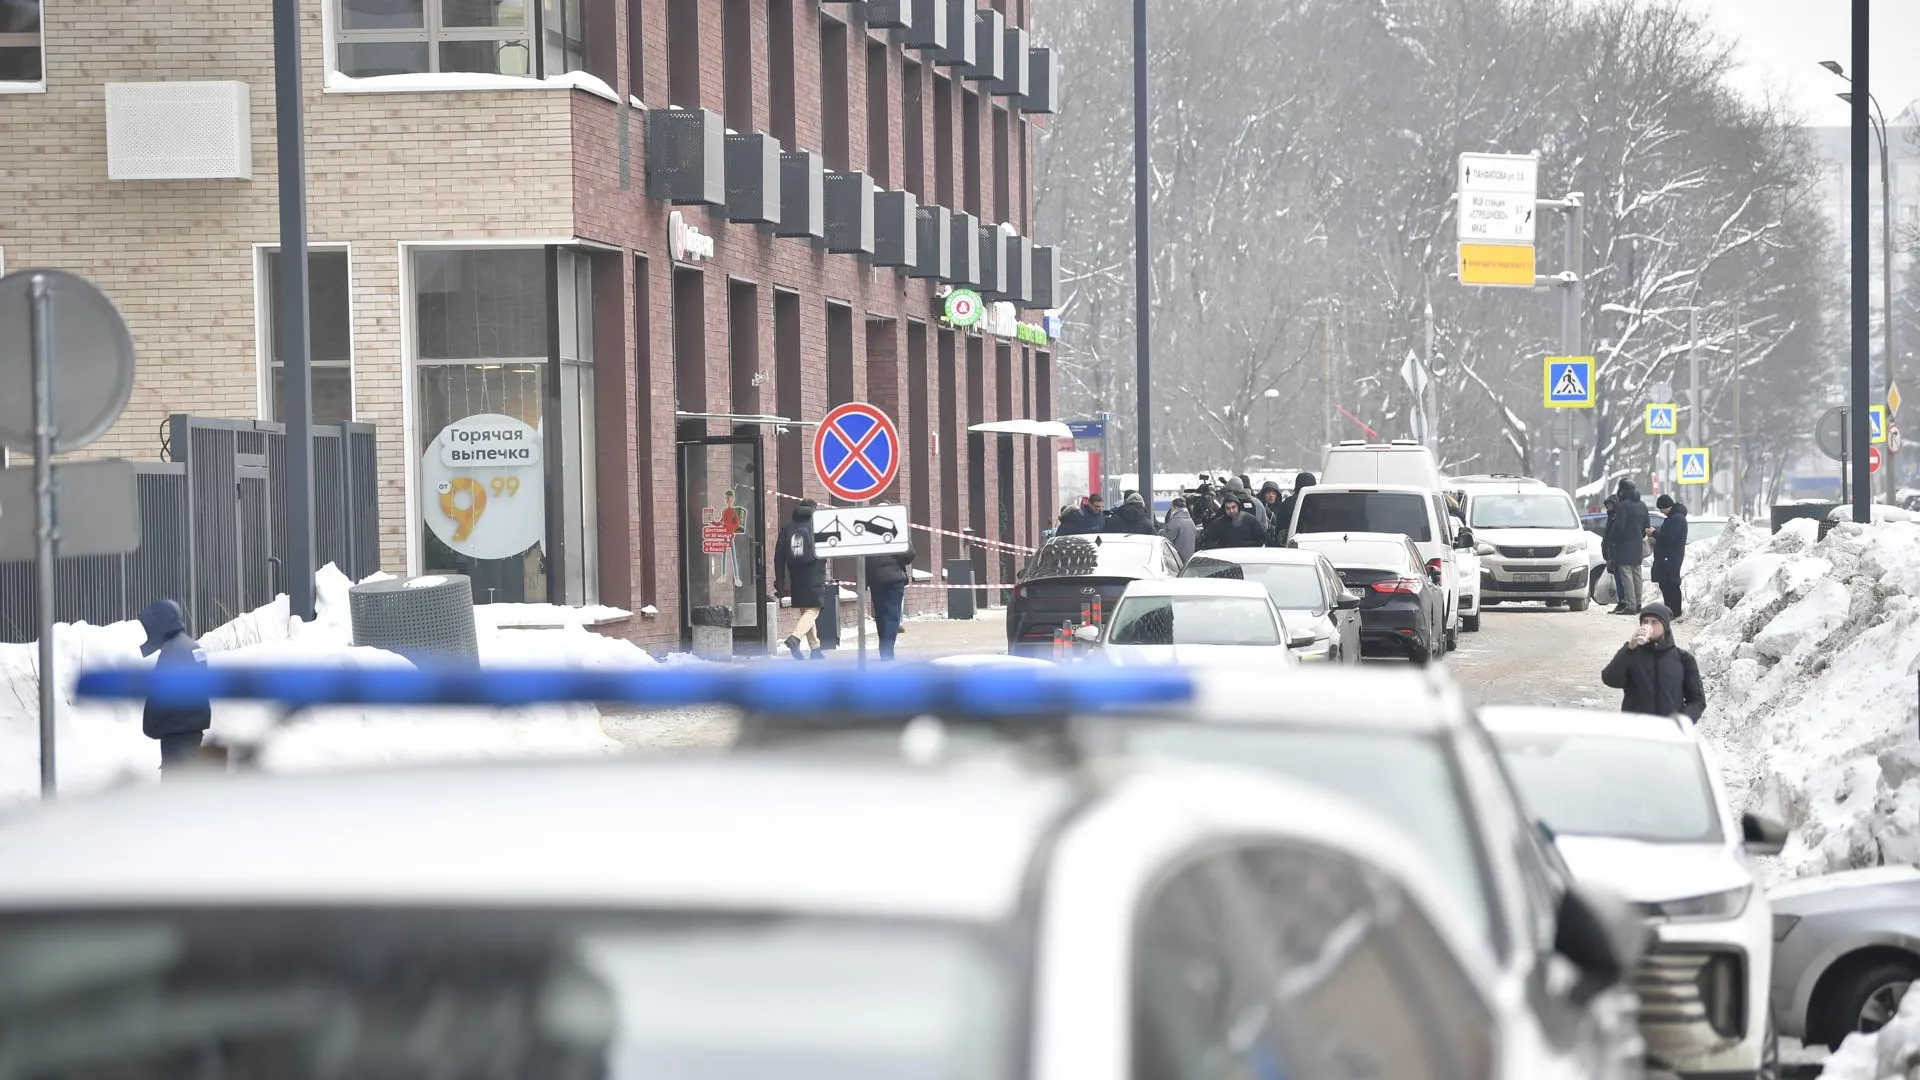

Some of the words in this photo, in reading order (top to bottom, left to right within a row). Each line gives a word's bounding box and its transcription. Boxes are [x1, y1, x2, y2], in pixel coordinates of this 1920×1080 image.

[1471, 223, 1487, 234] МКАД
[450, 428, 523, 444] Горячая
[451, 447, 530, 461] выпечка
[438, 482, 449, 490] от
[490, 476, 520, 498] 99
[439, 476, 488, 541] 9
